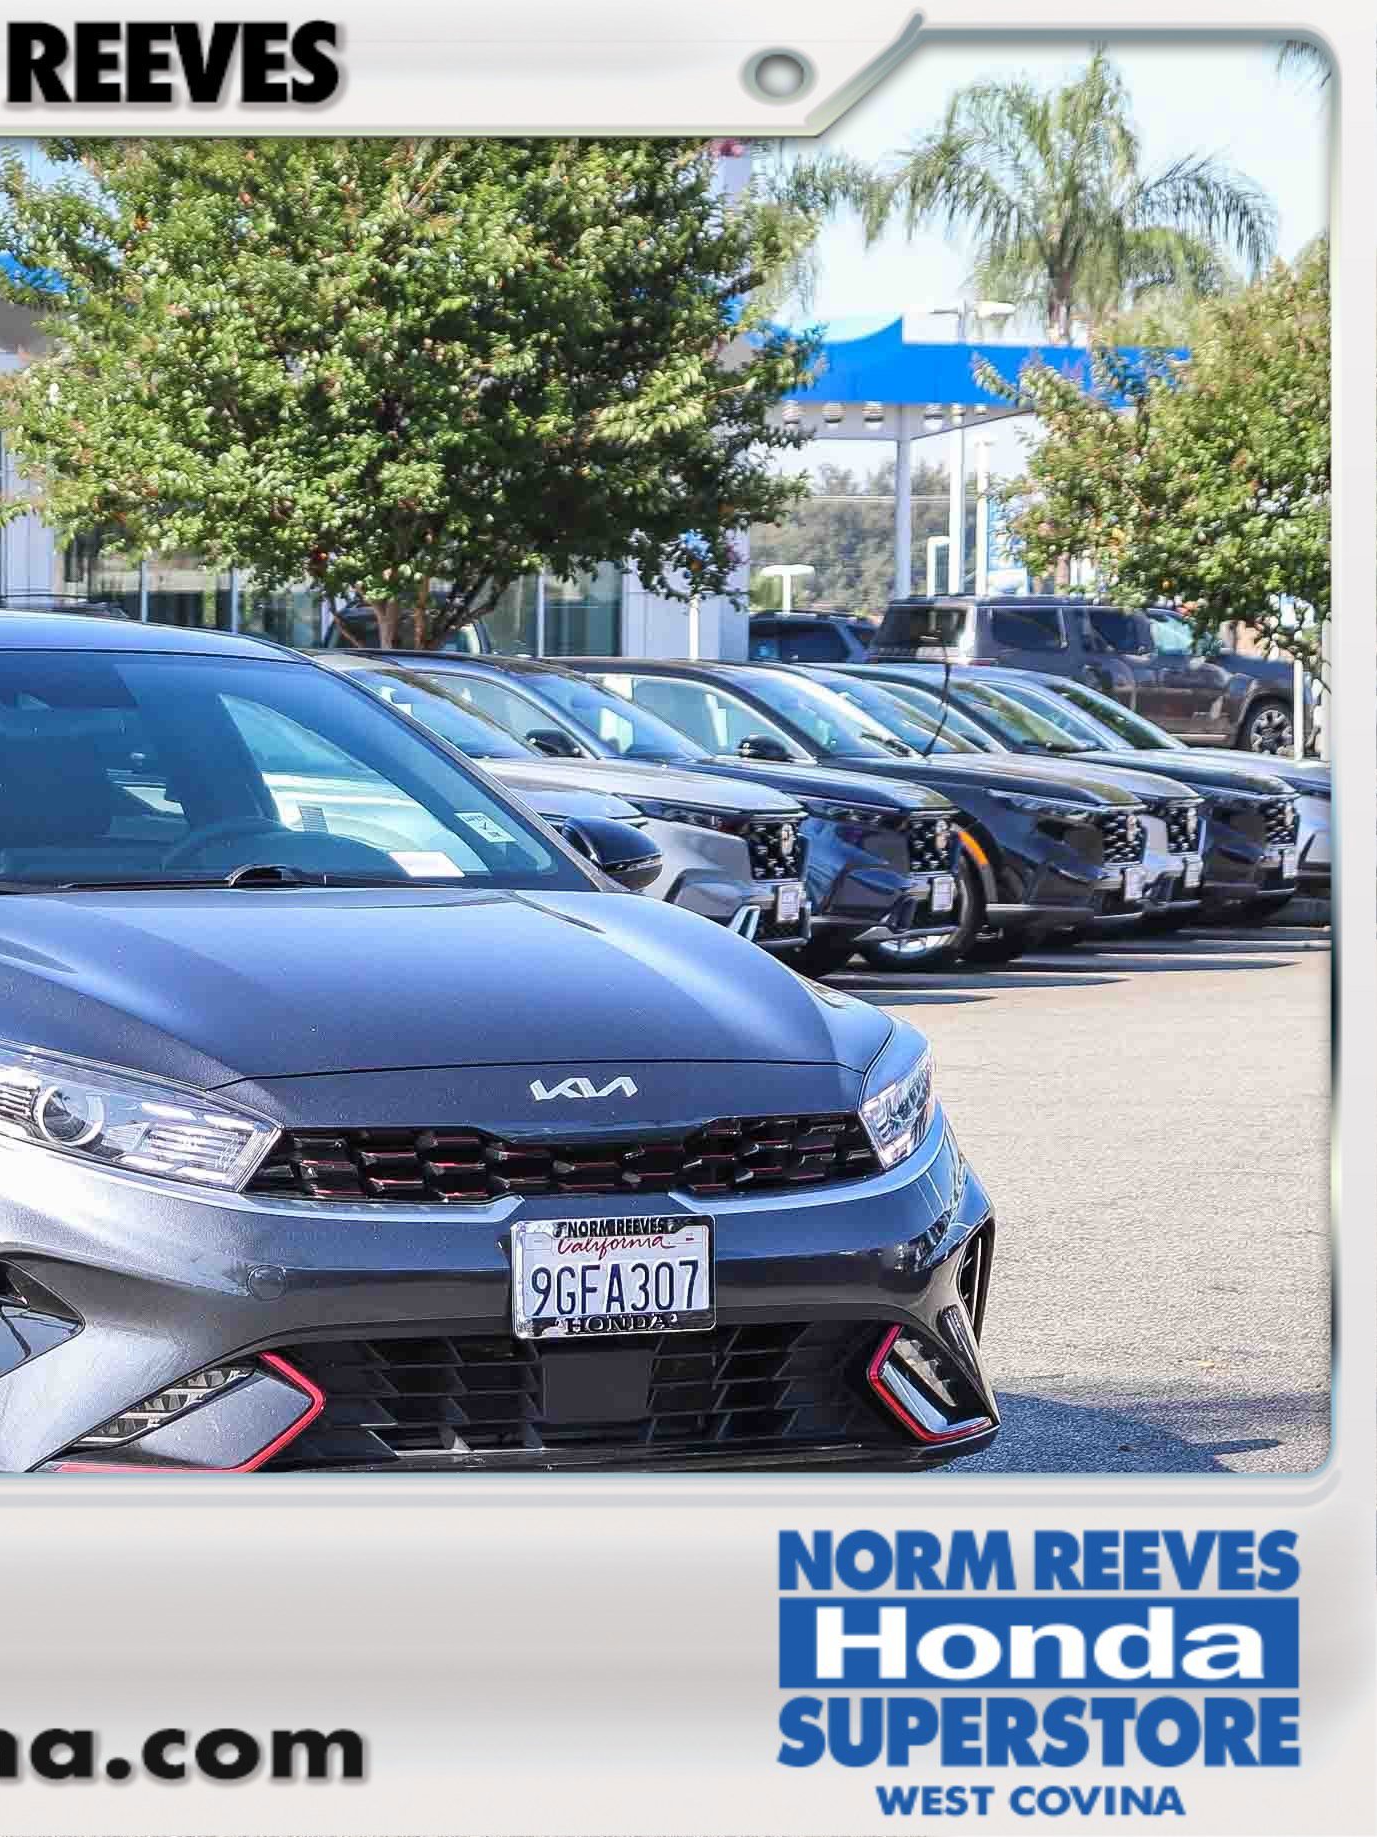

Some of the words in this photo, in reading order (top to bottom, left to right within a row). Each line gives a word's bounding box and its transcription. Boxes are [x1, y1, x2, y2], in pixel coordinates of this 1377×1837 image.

[529, 1076, 638, 1101] KIA
[568, 1220, 610, 1238] NORM
[612, 1218, 665, 1236] REEVES
[558, 1236, 677, 1260] California
[531, 1259, 699, 1316] 9GFA307
[566, 1314, 668, 1334] HONDA
